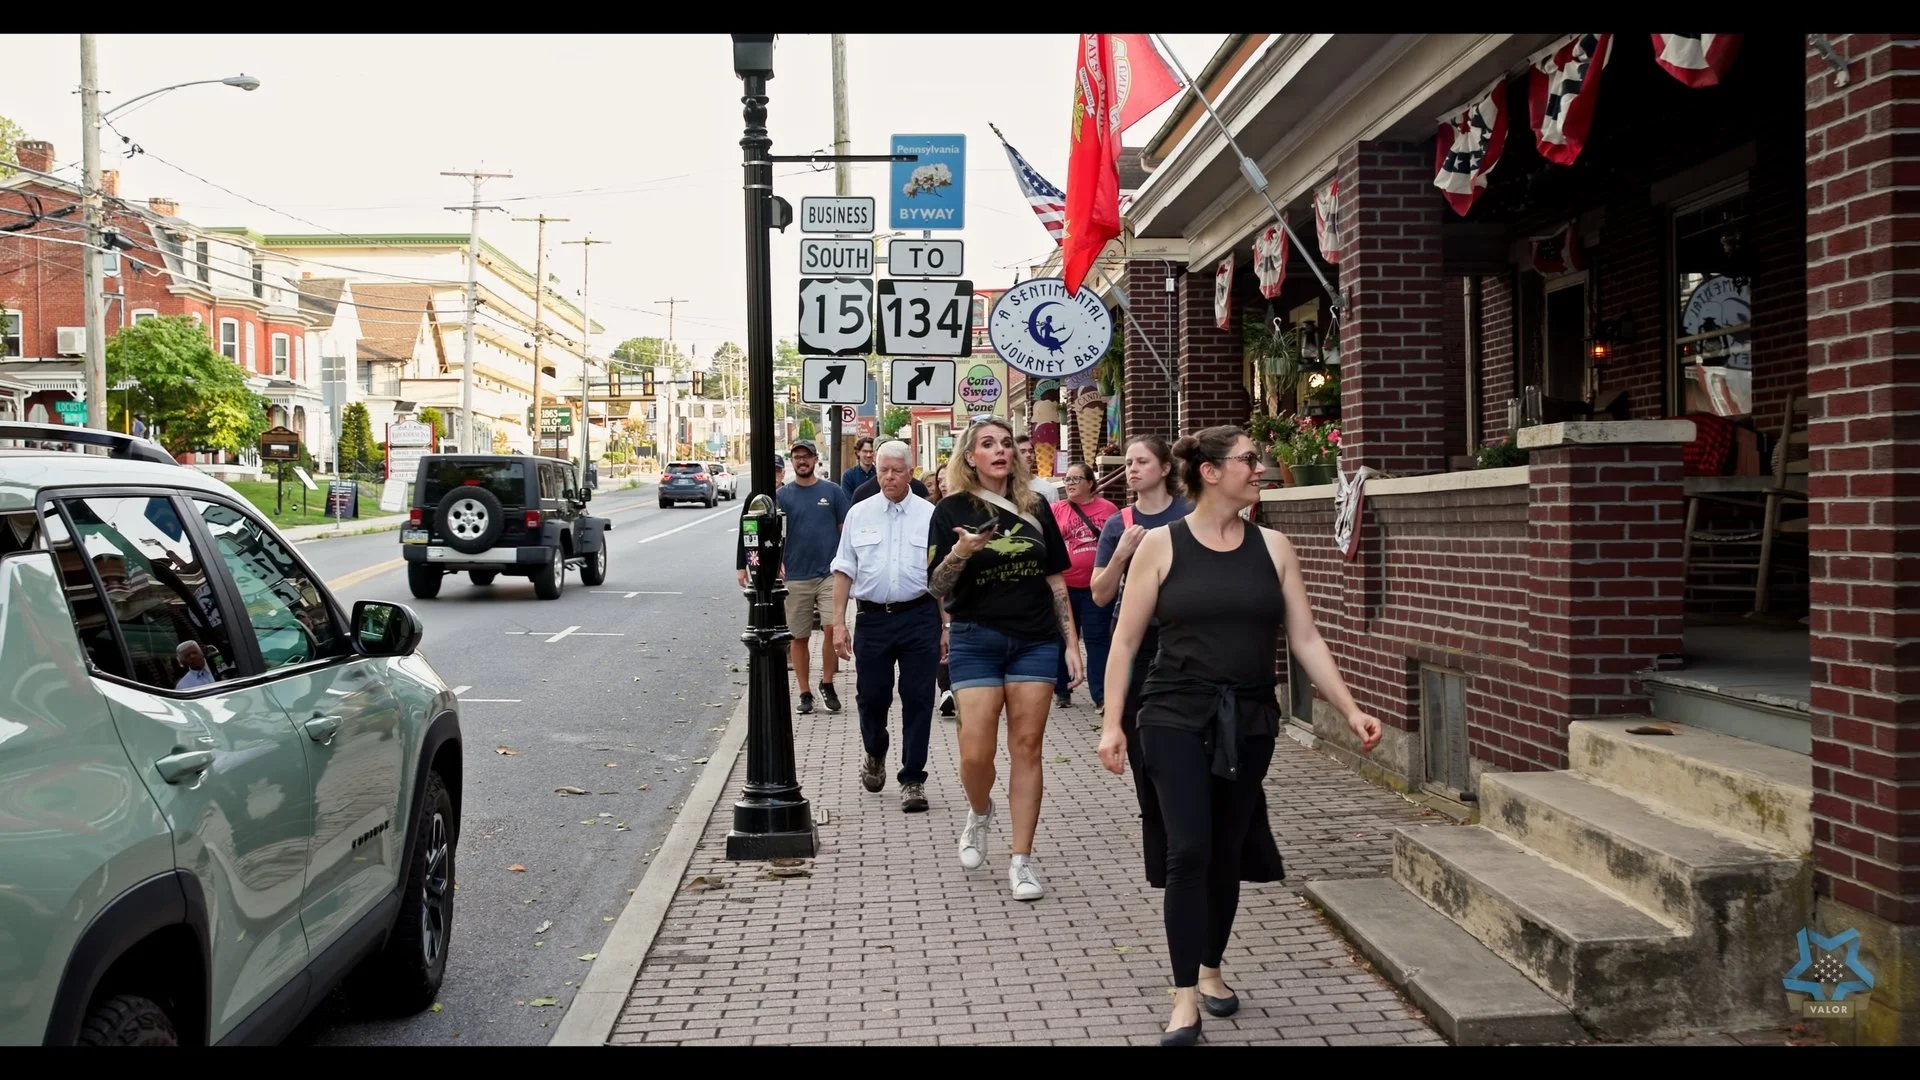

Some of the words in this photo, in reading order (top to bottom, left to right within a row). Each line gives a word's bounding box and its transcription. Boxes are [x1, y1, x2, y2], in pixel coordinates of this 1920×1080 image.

[897, 145, 960, 155] Pennsylvania
[809, 206, 867, 224] BUSINESS
[900, 208, 954, 220] BYWAY
[806, 244, 868, 268] SOUTH
[909, 248, 944, 268] TO
[998, 309, 1011, 320] A
[1010, 284, 1104, 322] SENTIMNTAL
[816, 294, 864, 334] 15
[886, 297, 963, 339] 134
[1001, 342, 1065, 373] JOURNEY
[1074, 344, 1100, 367] B&B
[967, 376, 995, 386] Cone
[962, 387, 998, 397] Sweet
[967, 403, 994, 412] Cone
